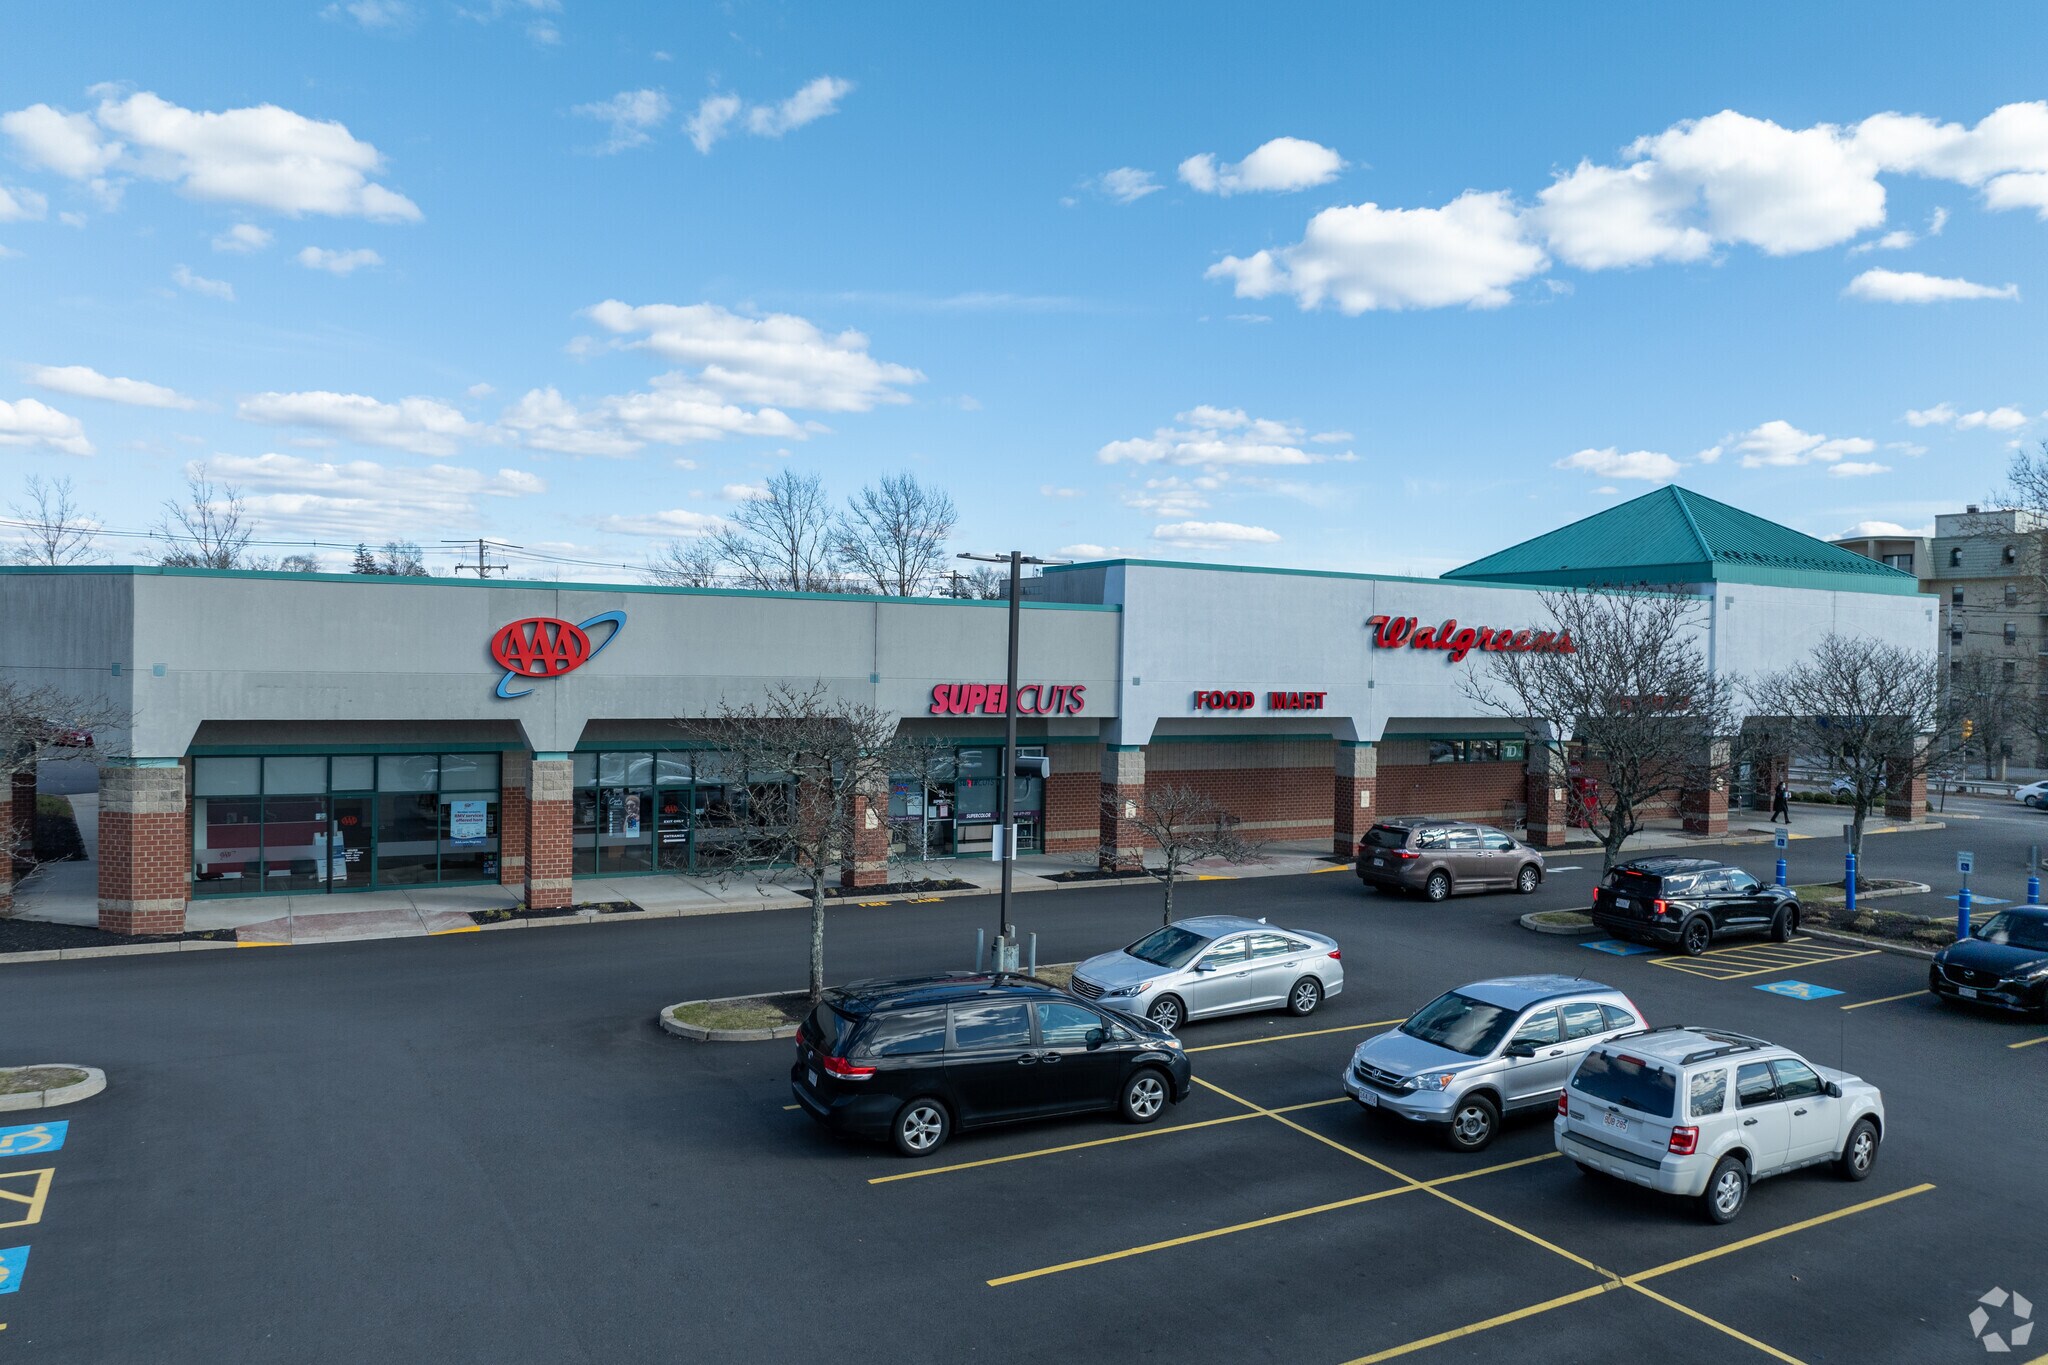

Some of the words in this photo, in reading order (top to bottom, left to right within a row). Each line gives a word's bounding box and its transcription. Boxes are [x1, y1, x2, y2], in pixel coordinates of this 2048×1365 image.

[500, 619, 583, 675] AAA
[1367, 614, 1577, 662] Walgreens
[1194, 690, 1256, 710] FOOD
[1269, 691, 1328, 710] MART
[1505, 745, 1517, 758] TD
